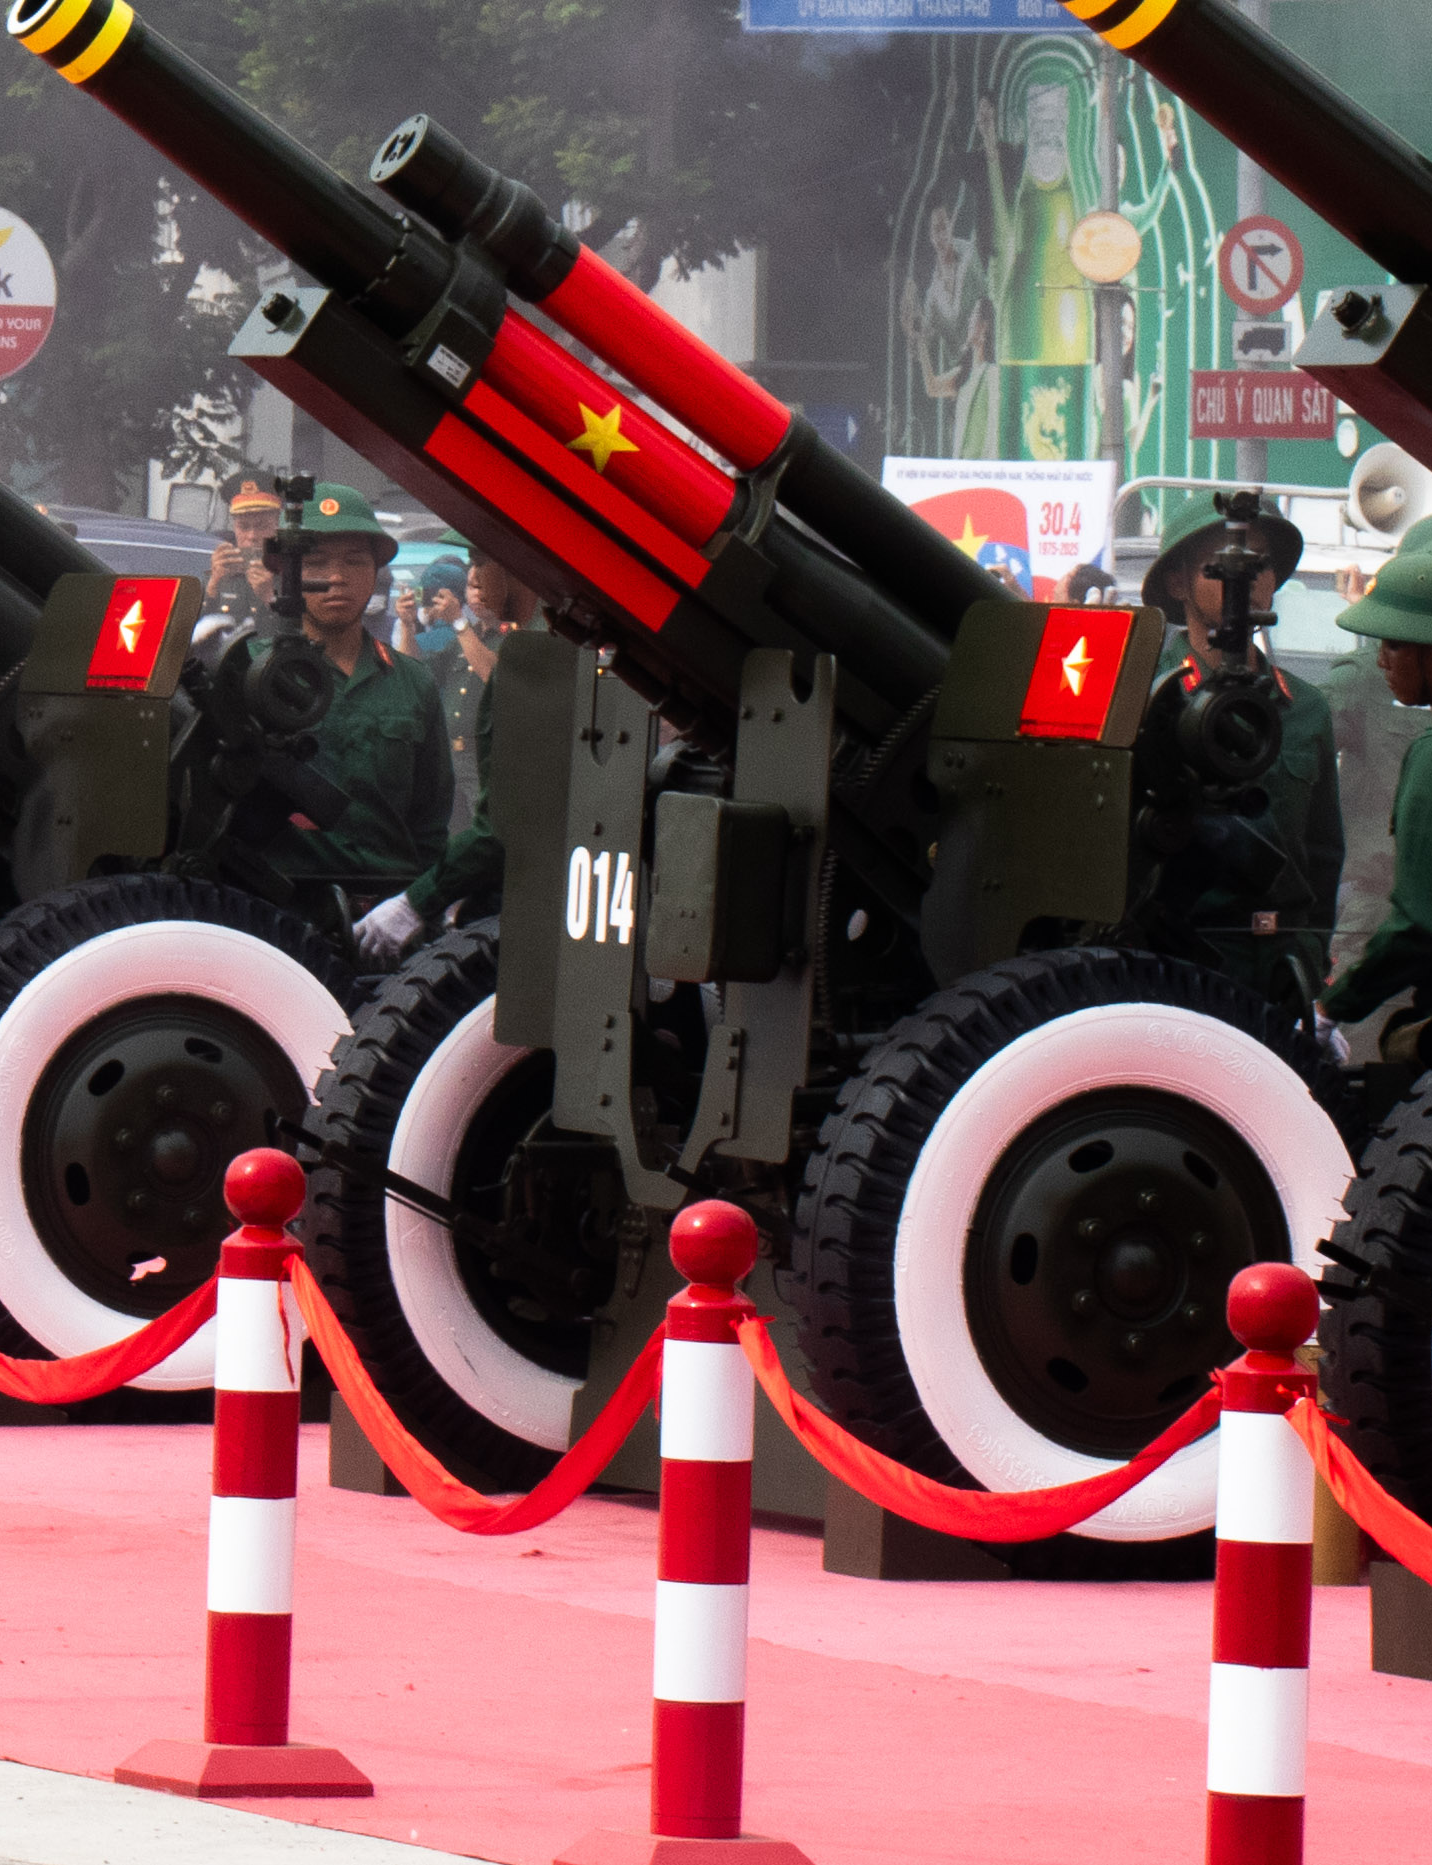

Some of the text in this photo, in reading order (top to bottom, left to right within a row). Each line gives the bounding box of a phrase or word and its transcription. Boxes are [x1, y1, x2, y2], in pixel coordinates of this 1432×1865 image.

[6, 316, 42, 331] YOUR
[1196, 377, 1330, 424] CHÚ Ý QUAN SÁT
[1039, 502, 1081, 537] 30.4
[1038, 541, 1079, 556] 1975-2025
[565, 845, 634, 945] 014
